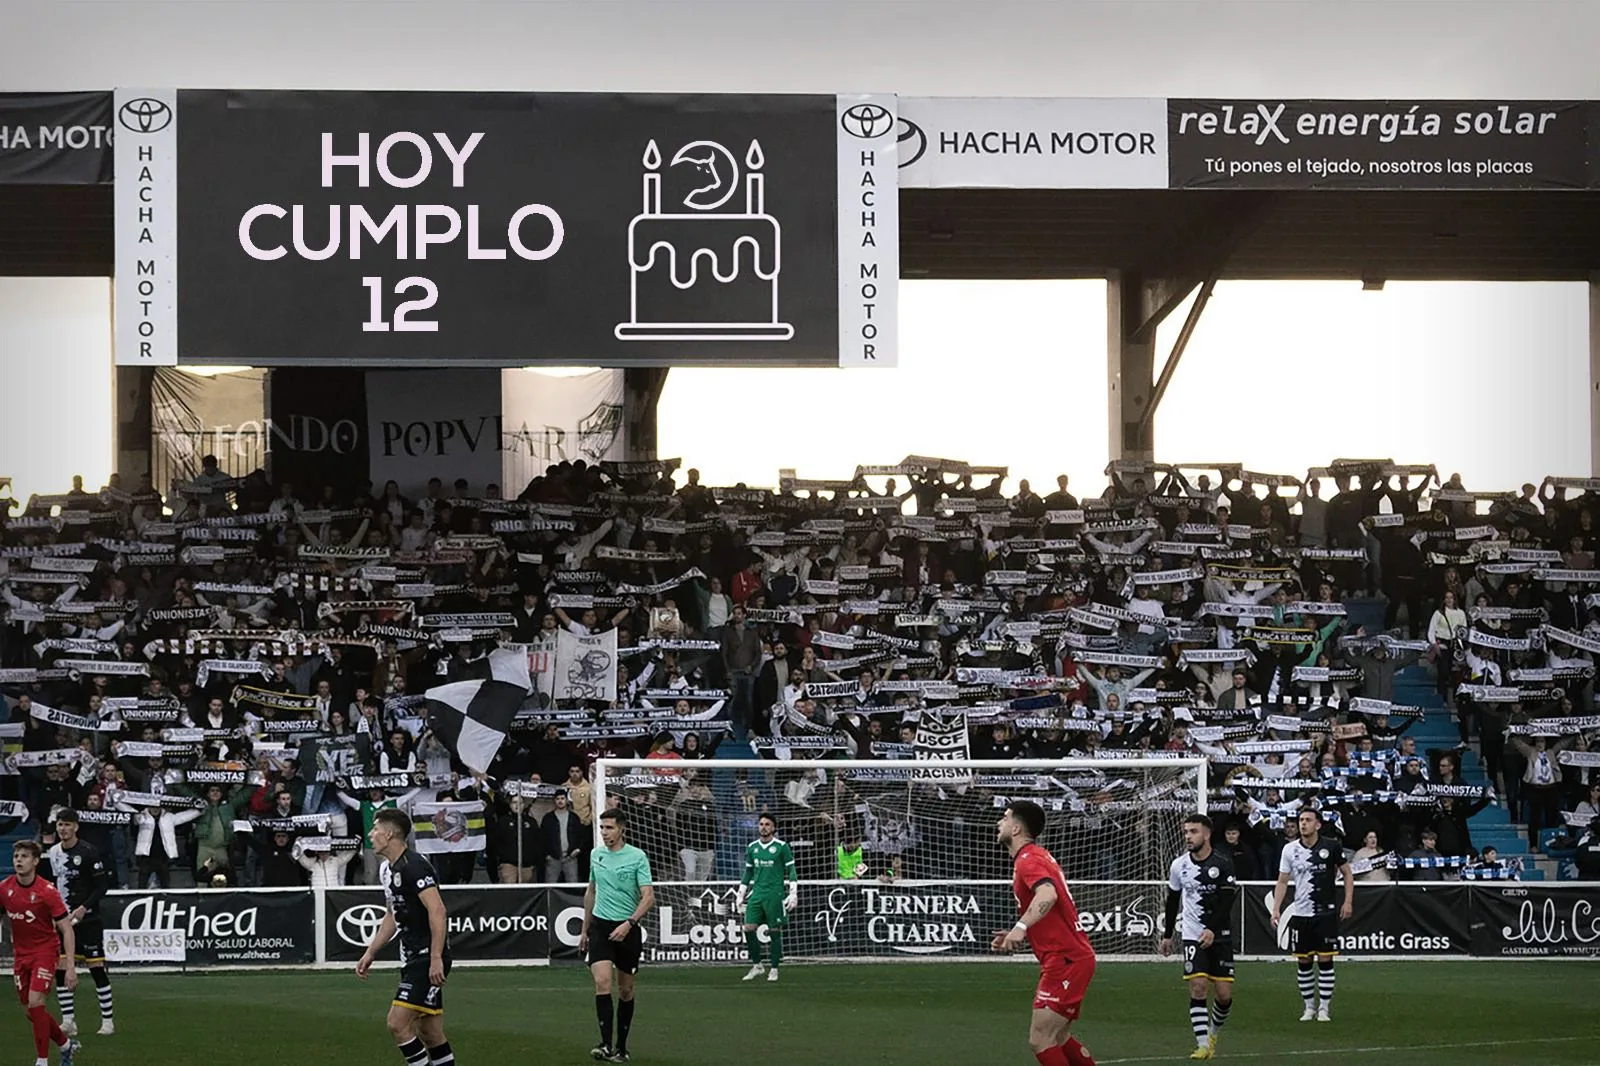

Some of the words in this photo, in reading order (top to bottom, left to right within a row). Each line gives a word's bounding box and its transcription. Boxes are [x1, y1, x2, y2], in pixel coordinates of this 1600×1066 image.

[1297, 104, 1441, 142] energía
[1454, 105, 1556, 135] solar
[0, 126, 31, 149] HA
[938, 131, 1043, 154] HACHA
[1051, 131, 1156, 154] MOTOR
[321, 131, 486, 188] HOY
[1205, 157, 1226, 173] Tú
[1230, 161, 1283, 178] pones
[1287, 157, 1302, 174] el
[1306, 157, 1365, 178] tejado,
[1369, 159, 1442, 174] nosotros
[1447, 157, 1472, 174] las
[1476, 157, 1534, 178] placas
[138, 145, 154, 243] HACHA
[860, 150, 876, 248] HACHA
[238, 203, 565, 261] CUMPLO
[136, 259, 155, 358] MOTOR
[362, 276, 439, 332] 12
[859, 263, 878, 360] MOTOR
[213, 415, 360, 464] FONDO
[369, 623, 430, 641] UNIONISTAS
[866, 629, 920, 649] UNIONISTAS
[1253, 631, 1280, 640] NUNCA
[1281, 633, 1289, 641] SE
[1290, 634, 1314, 642] RINDE
[122, 709, 178, 720] UNIONISTAS
[264, 719, 319, 730] UNIONISTAS
[917, 733, 965, 746] USCF
[186, 771, 245, 781] UNIONISTAS
[911, 768, 969, 780] RACISM
[1427, 784, 1483, 796] UNIONISTAS
[861, 888, 981, 915] TERNERA
[449, 918, 474, 932] HA
[480, 916, 548, 933] MOTOR
[867, 916, 977, 944] CHARRA
[121, 934, 184, 949] VERSUS
[249, 938, 295, 949] LABORAL
[1400, 932, 1450, 951] Grass
[1501, 947, 1550, 955] GASTROBAR
[651, 948, 750, 961] Inmobiliaria
[1184, 944, 1197, 960] 19
